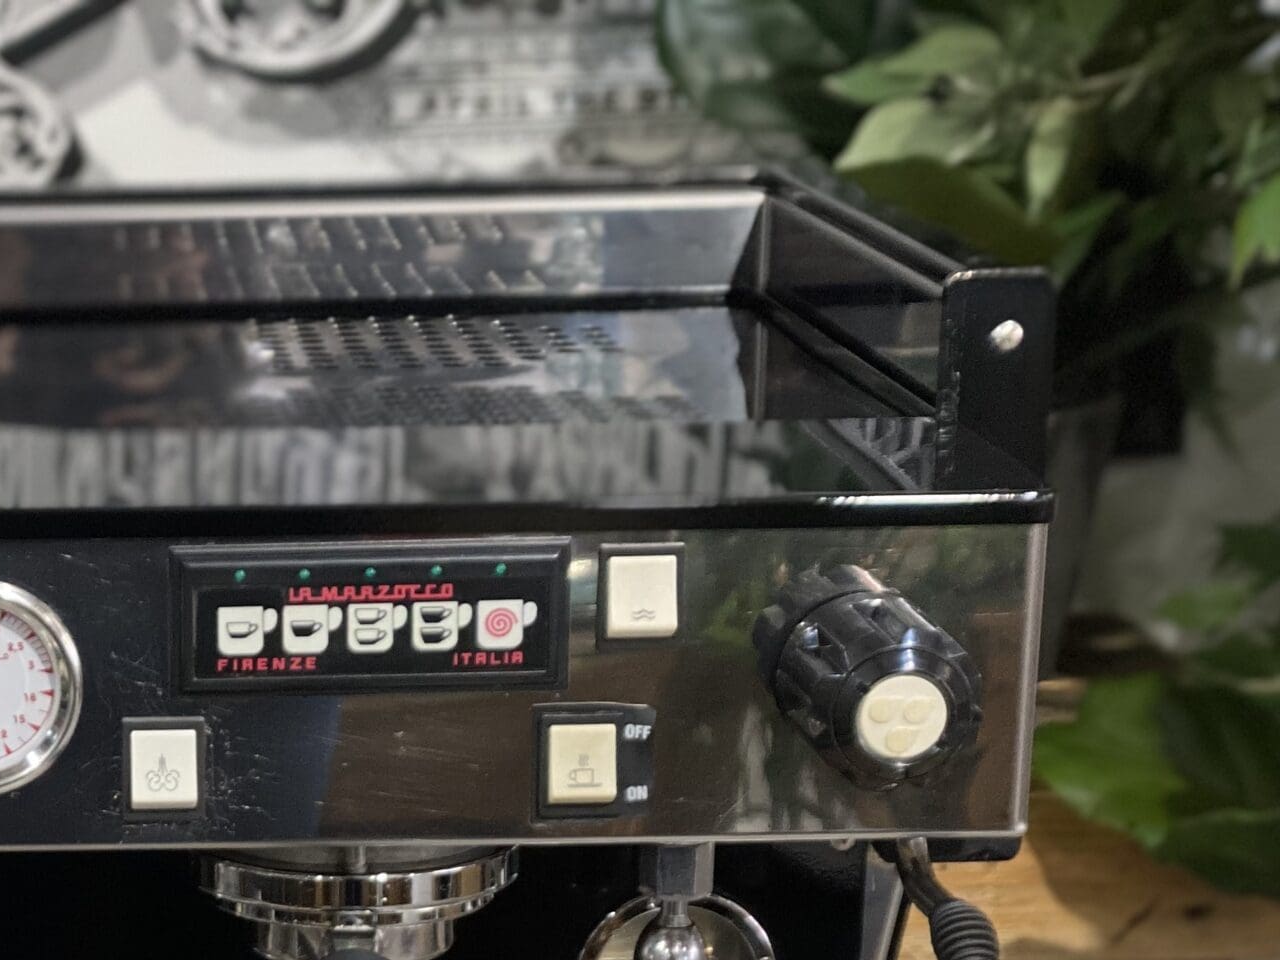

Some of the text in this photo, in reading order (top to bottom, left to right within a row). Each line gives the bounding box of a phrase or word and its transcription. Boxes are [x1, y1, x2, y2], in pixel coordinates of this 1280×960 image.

[217, 656, 318, 673] FIRENZE
[452, 651, 524, 667] ITALIA
[624, 723, 652, 740] OFF
[625, 785, 649, 802] ON
